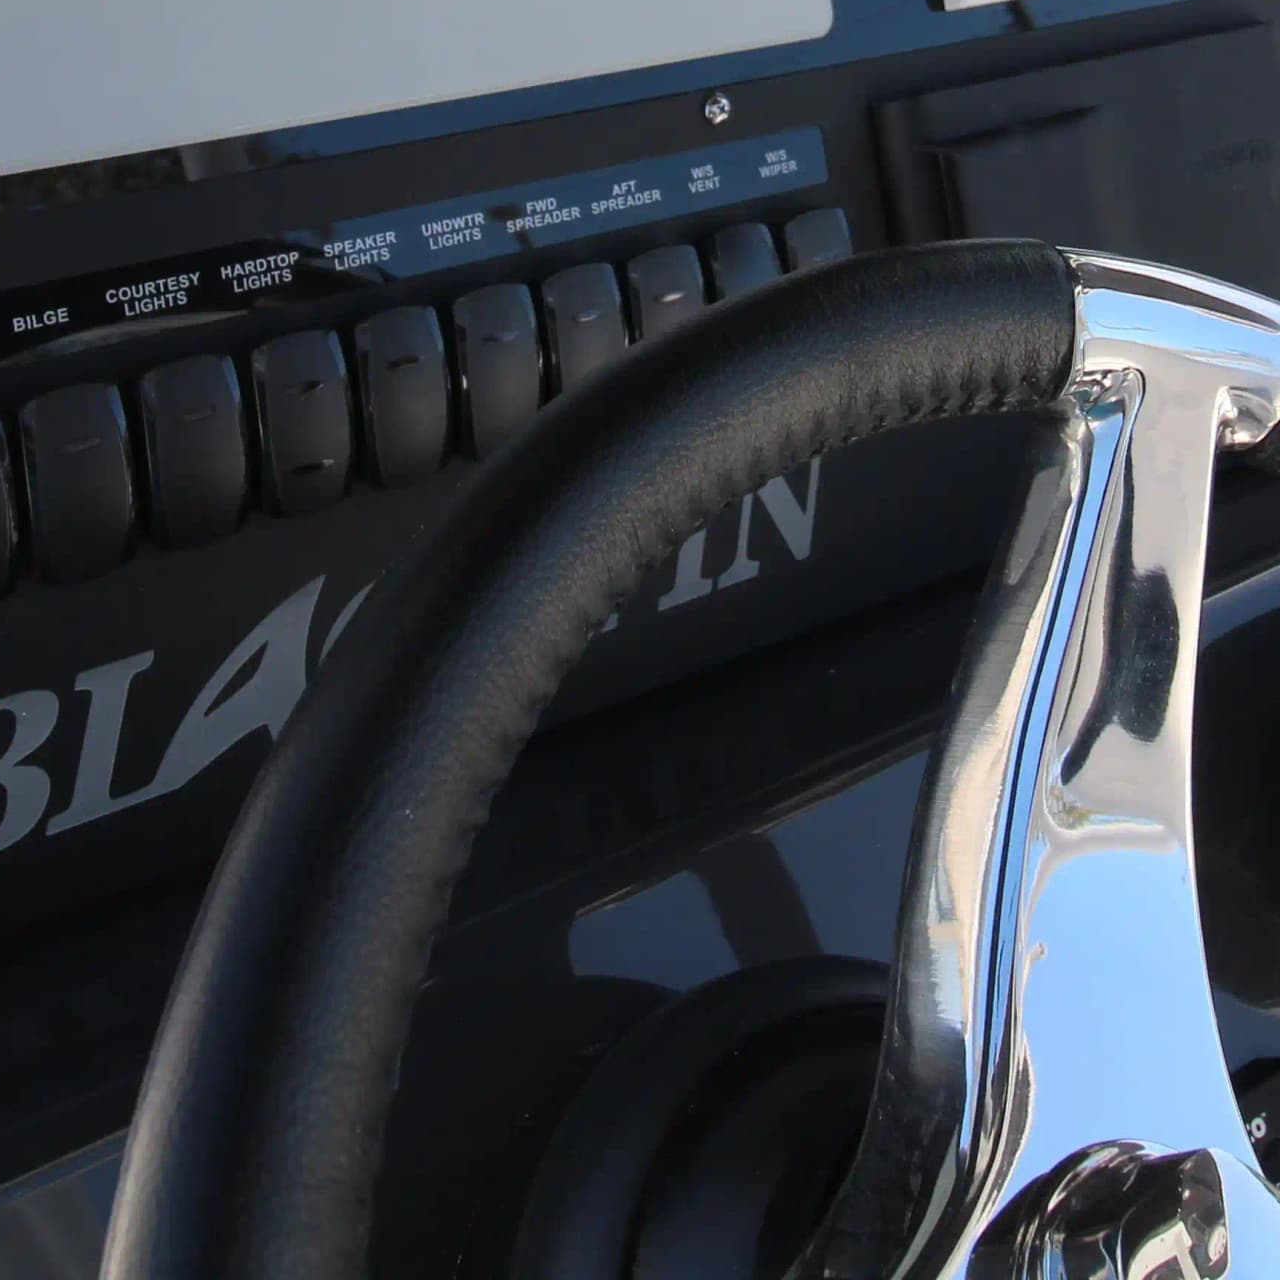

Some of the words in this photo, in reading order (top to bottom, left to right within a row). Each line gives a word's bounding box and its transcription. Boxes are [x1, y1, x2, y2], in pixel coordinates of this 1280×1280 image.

[758, 159, 798, 178] WIPER
[764, 148, 789, 166] W/S
[687, 174, 720, 193] VENT
[690, 163, 714, 180] W/S
[611, 180, 638, 198] AFT
[525, 196, 557, 216] FWD
[590, 189, 662, 216] SPREADER
[421, 211, 485, 238] UNDWTR
[505, 206, 581, 234] SPREADER
[323, 230, 397, 258] SPEAKER
[429, 227, 482, 250] LIGHTS
[220, 250, 300, 280] HARDTOP
[334, 246, 391, 272] LIGHTS
[105, 271, 201, 304] COURTESY
[233, 267, 293, 293] LIGHTS
[124, 290, 188, 317] LIGHTS
[12, 306, 70, 333] BILGE
